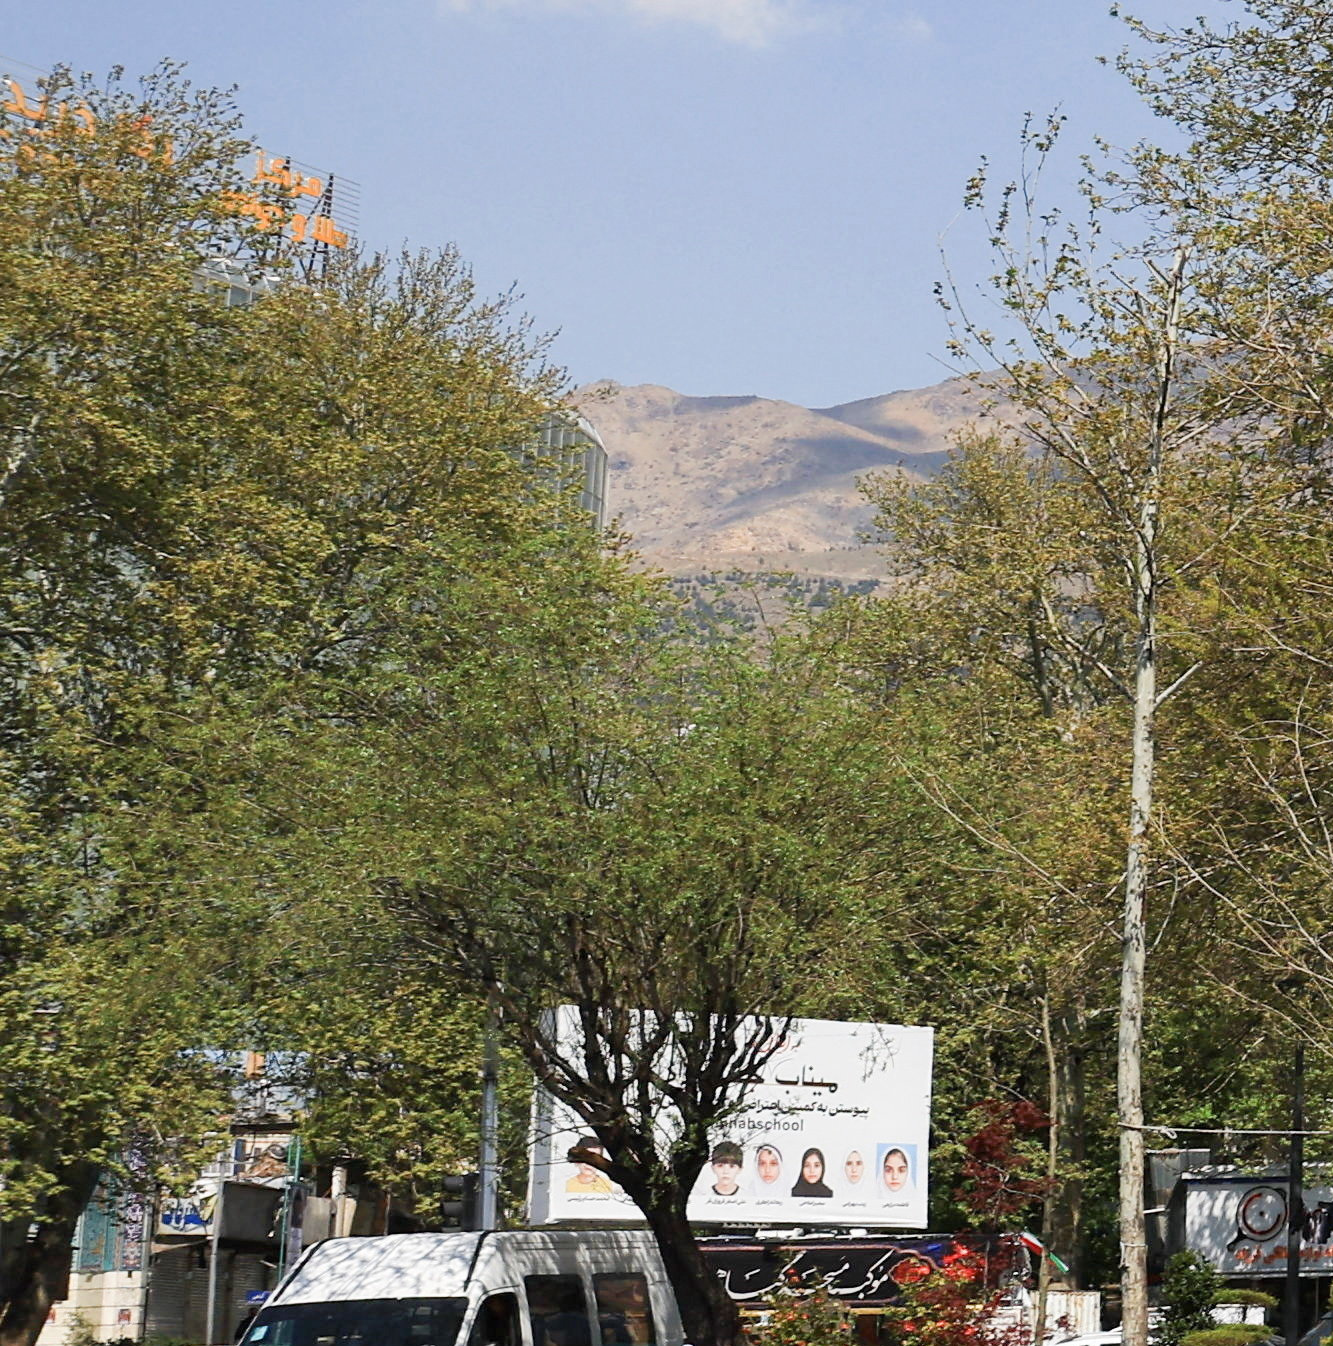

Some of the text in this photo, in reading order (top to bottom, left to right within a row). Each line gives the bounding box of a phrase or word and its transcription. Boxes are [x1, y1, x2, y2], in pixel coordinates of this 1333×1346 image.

[775, 1065, 838, 1096] میناب
[817, 1102, 828, 1117] به
[829, 1102, 870, 1119] پیوستن
